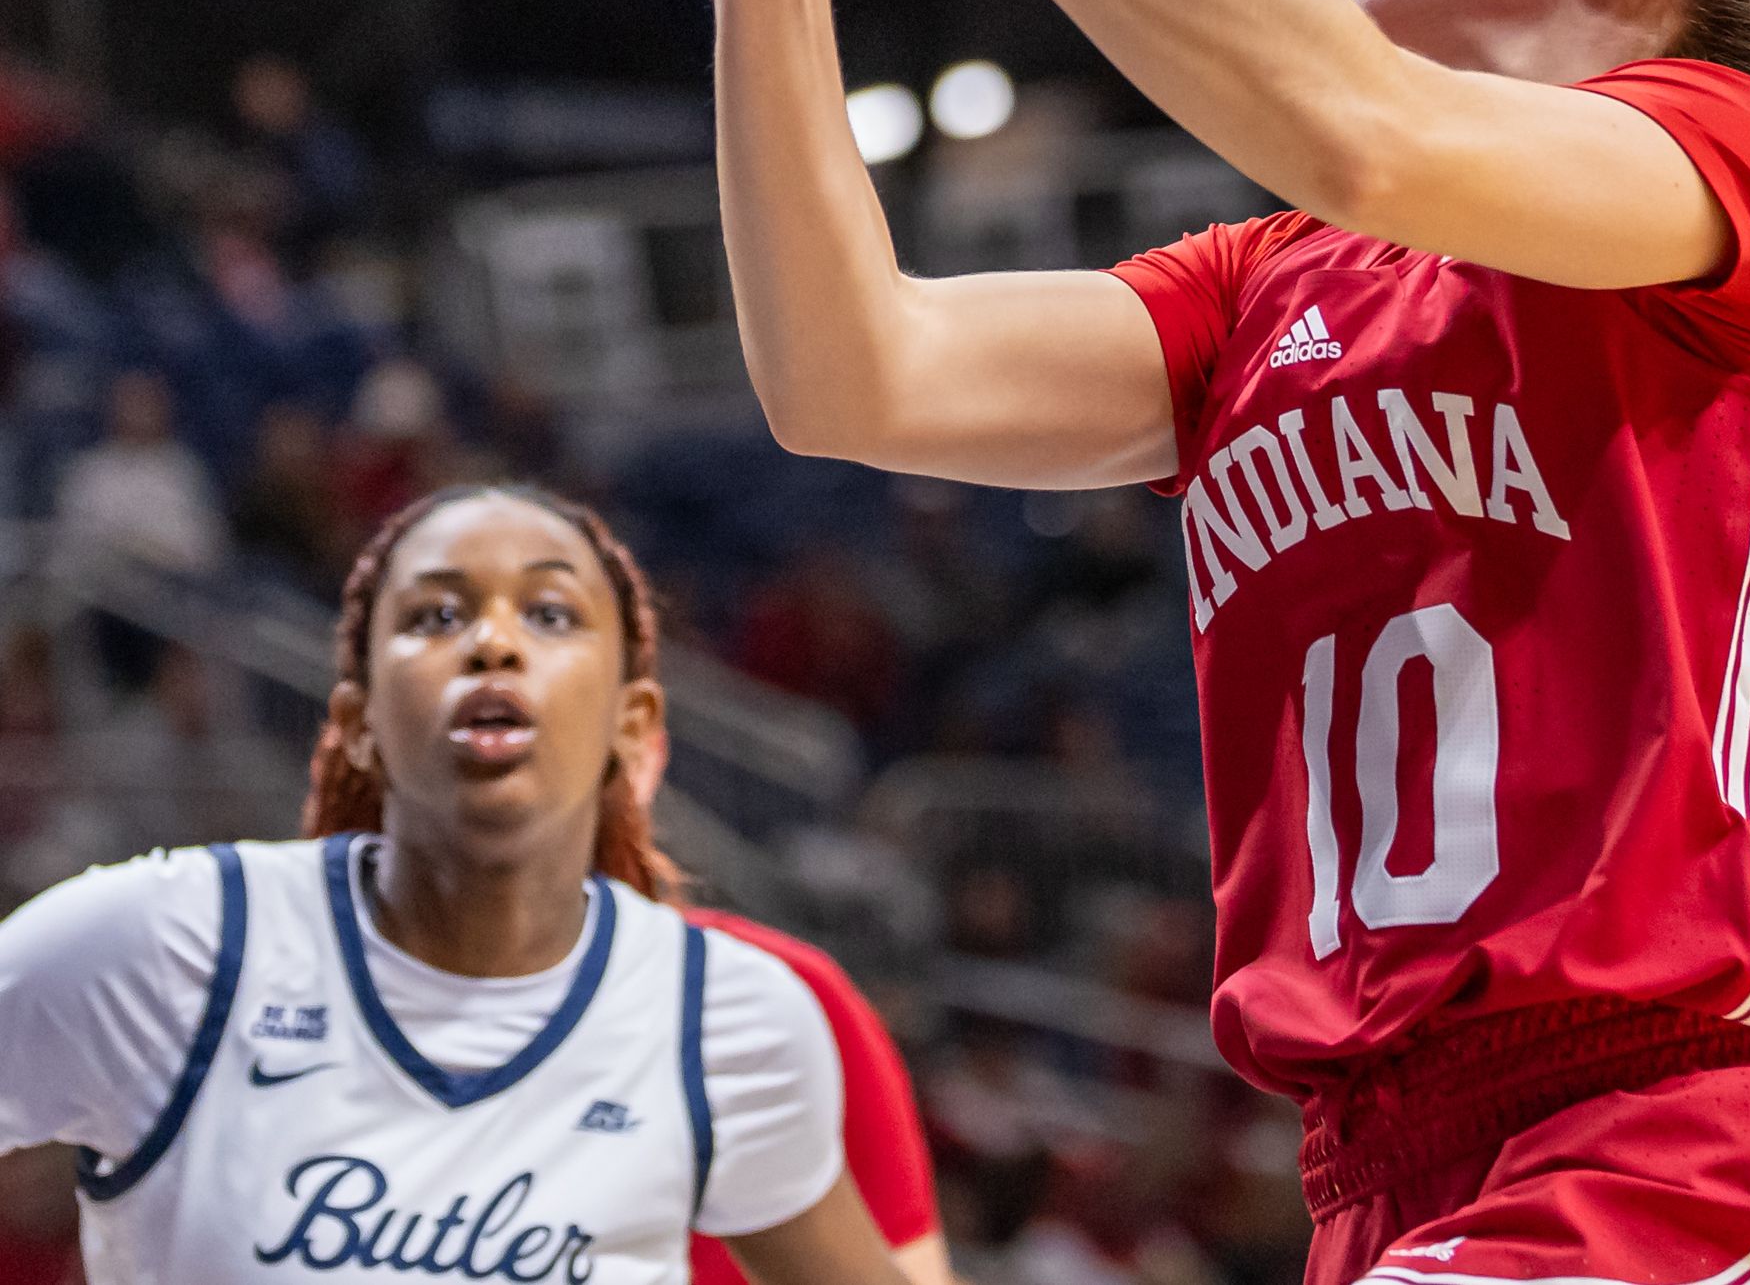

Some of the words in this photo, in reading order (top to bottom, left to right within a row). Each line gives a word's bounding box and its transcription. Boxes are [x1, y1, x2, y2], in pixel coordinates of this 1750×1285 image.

[1269, 339, 1343, 369] adidas
[1180, 388, 1572, 635] INDIANA
[1301, 602, 1500, 962] 10
[254, 1154, 596, 1285] Butler
